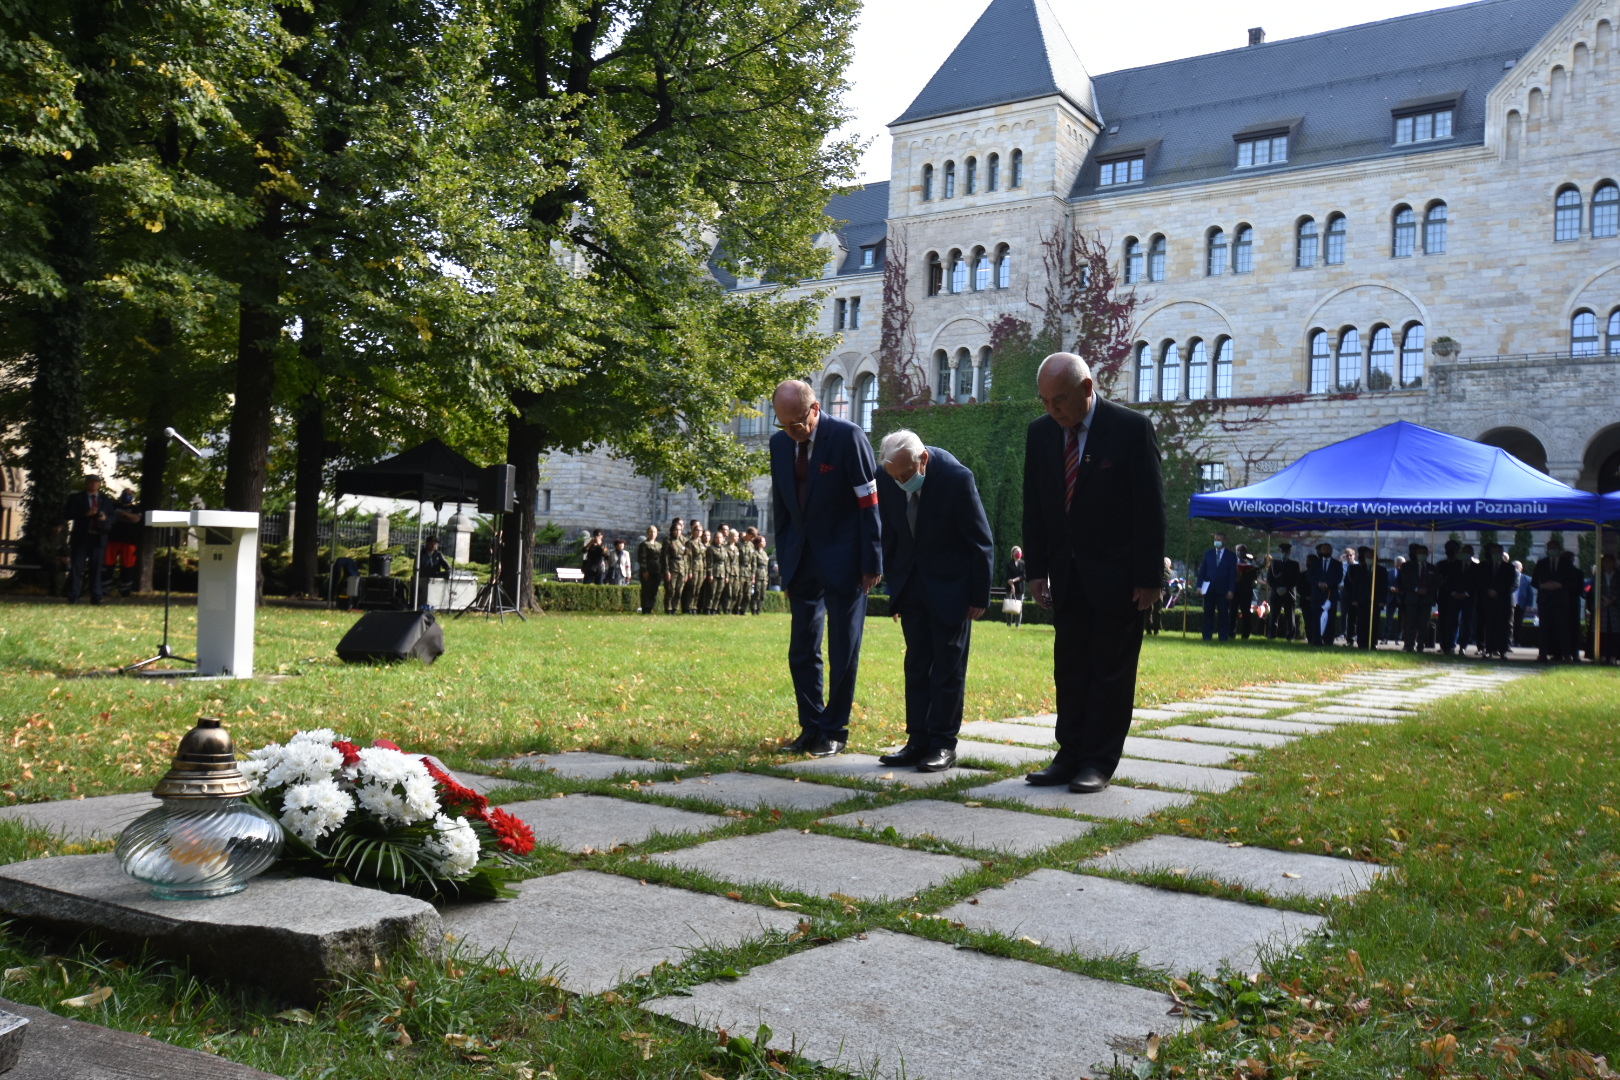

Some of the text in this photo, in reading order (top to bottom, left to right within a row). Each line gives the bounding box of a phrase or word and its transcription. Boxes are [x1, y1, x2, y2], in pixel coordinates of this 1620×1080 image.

[1228, 500, 1548, 515] Wielkopolski Urząd Wojewódzki w Poznaniu
